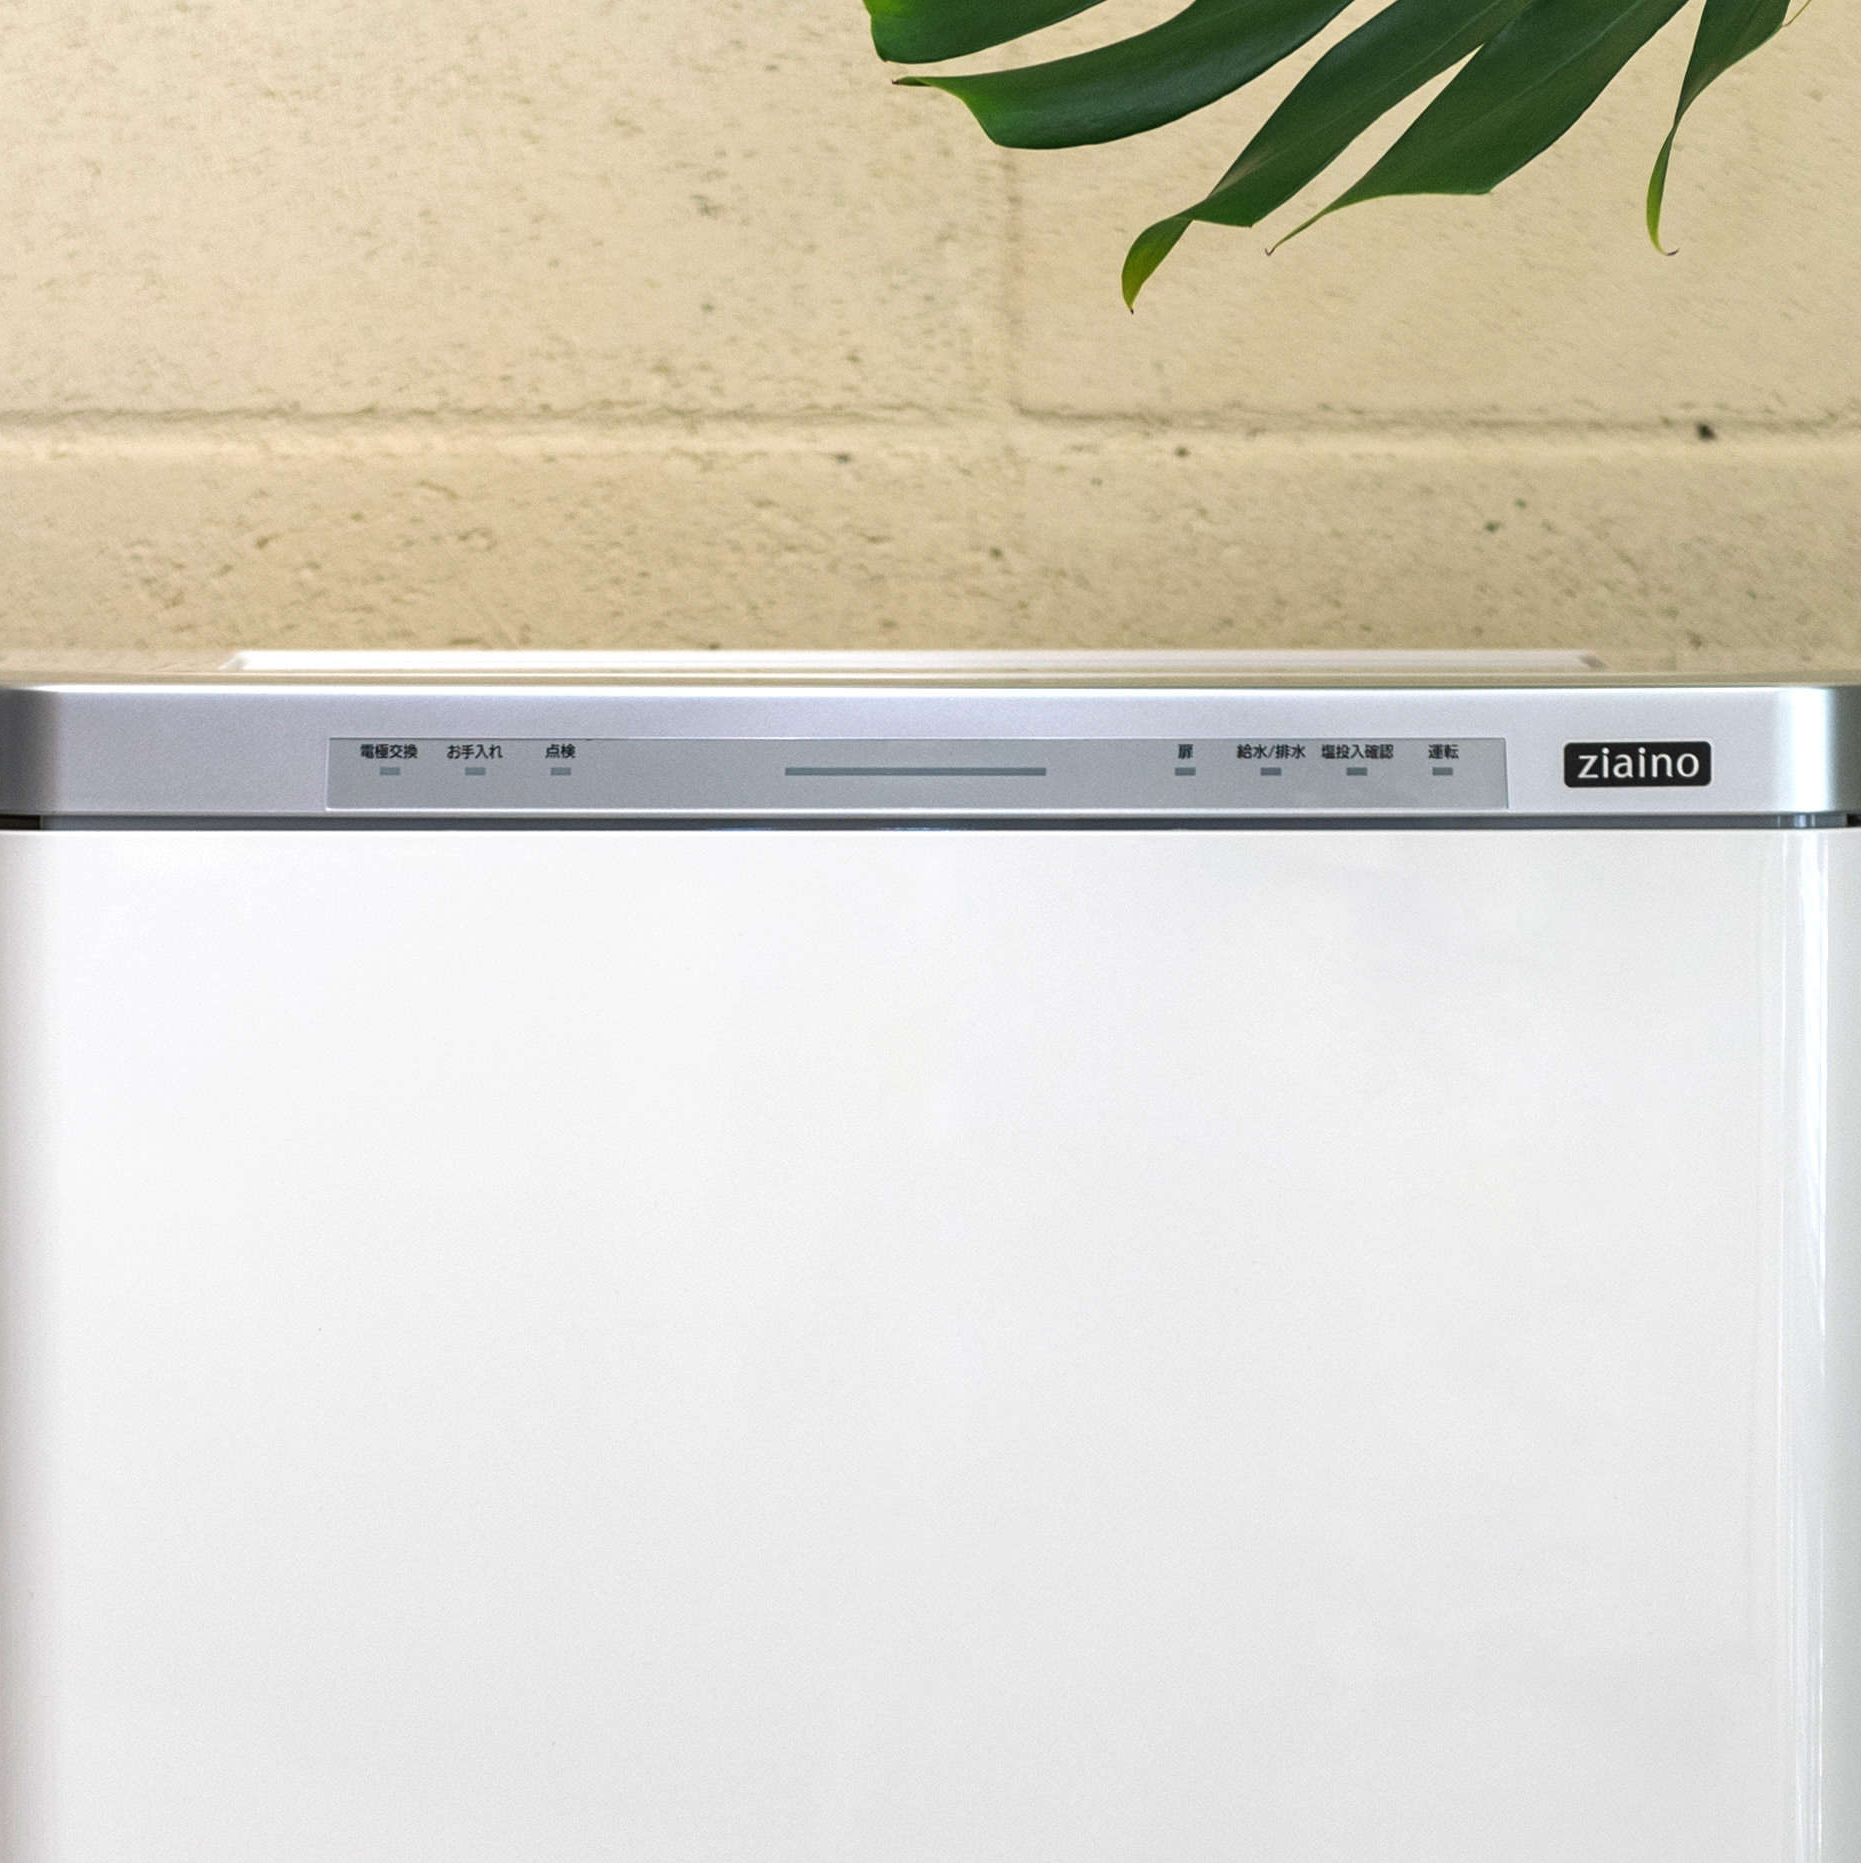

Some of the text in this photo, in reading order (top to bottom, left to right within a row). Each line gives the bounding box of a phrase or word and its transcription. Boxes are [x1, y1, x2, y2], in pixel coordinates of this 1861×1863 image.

[360, 743, 418, 759] 電極交換
[446, 743, 503, 759] お手入れ
[544, 743, 576, 759] 点検
[1177, 744, 1194, 760] 扉
[1236, 744, 1306, 760] 給水/排水
[1321, 744, 1394, 760] 塩投入確認
[1427, 744, 1460, 760] 運転
[1577, 747, 1700, 779] ziaino
